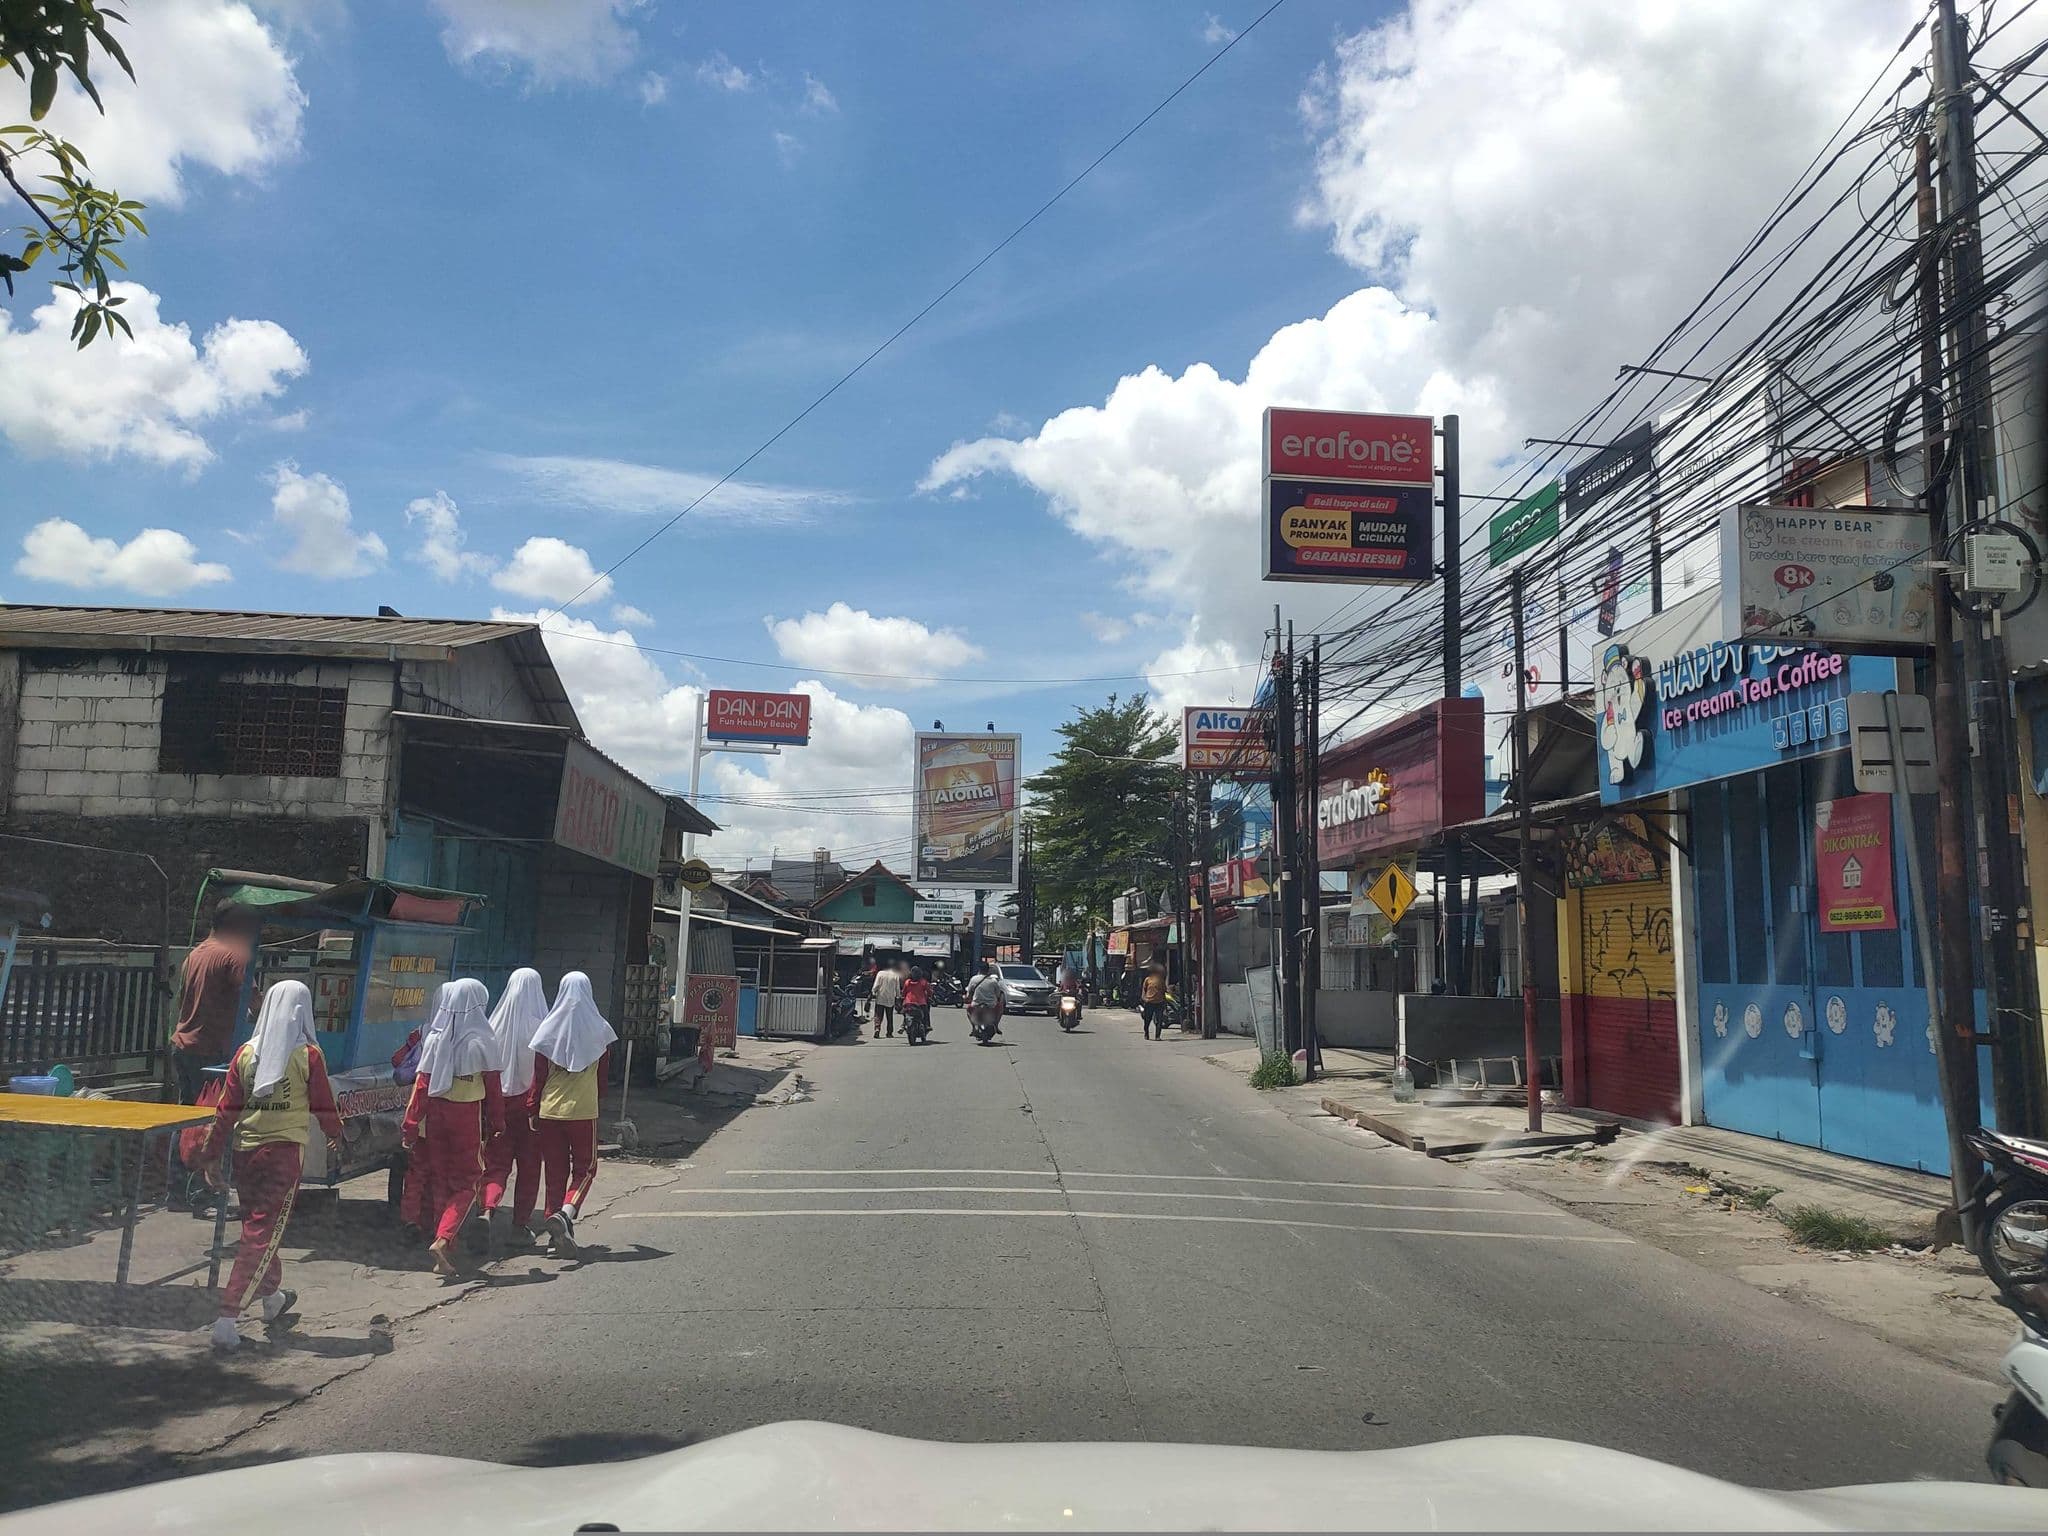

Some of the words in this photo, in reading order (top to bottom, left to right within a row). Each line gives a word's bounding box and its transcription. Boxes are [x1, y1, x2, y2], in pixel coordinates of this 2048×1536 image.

[1281, 431, 1412, 463] erafone
[1359, 500, 1369, 509] di
[1369, 501, 1389, 510] sini
[1290, 518, 1348, 531] BANYAK
[1358, 521, 1407, 534] MUDAH
[1776, 517, 1827, 531] HAPPY
[1835, 520, 1873, 533] BEAR
[1290, 530, 1347, 541] PROMONYA
[1359, 533, 1406, 543] CICILNYA
[1777, 534, 1796, 545] Ice
[1301, 550, 1360, 563] GARANSI
[1360, 553, 1402, 565] RESMI
[1750, 551, 1793, 562] produk
[1796, 551, 1826, 563] baru
[1830, 554, 1859, 567] yang
[1658, 639, 1744, 702] HAPPY
[717, 697, 756, 717] DAN
[763, 700, 802, 719] DAN
[720, 718, 735, 726] Fun
[737, 719, 768, 729] Healthy
[770, 720, 799, 730] Beauty
[1661, 708, 1682, 731] Ice
[934, 784, 994, 804] Aroma
[1318, 780, 1382, 830] erafone
[1823, 831, 1882, 853] DIKONTRAK
[391, 987, 425, 1007] PADANG
